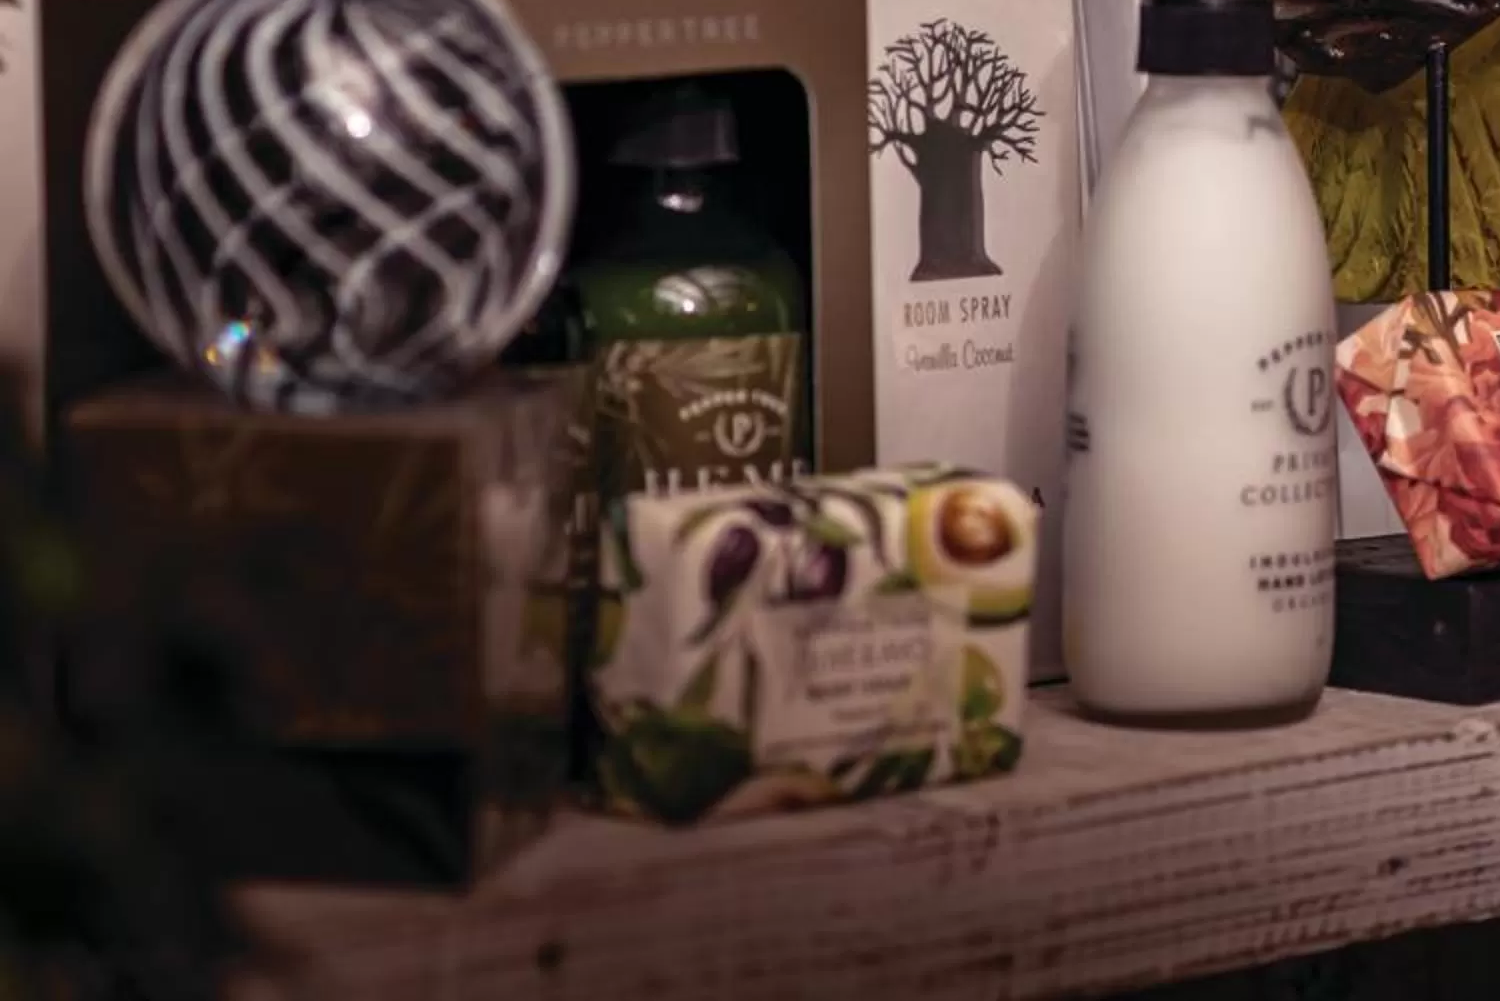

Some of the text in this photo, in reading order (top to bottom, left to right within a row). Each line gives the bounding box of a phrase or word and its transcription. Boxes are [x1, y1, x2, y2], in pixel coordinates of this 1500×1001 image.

[904, 295, 1012, 327] ROOM SPRAY
[1308, 367, 1325, 417] P
